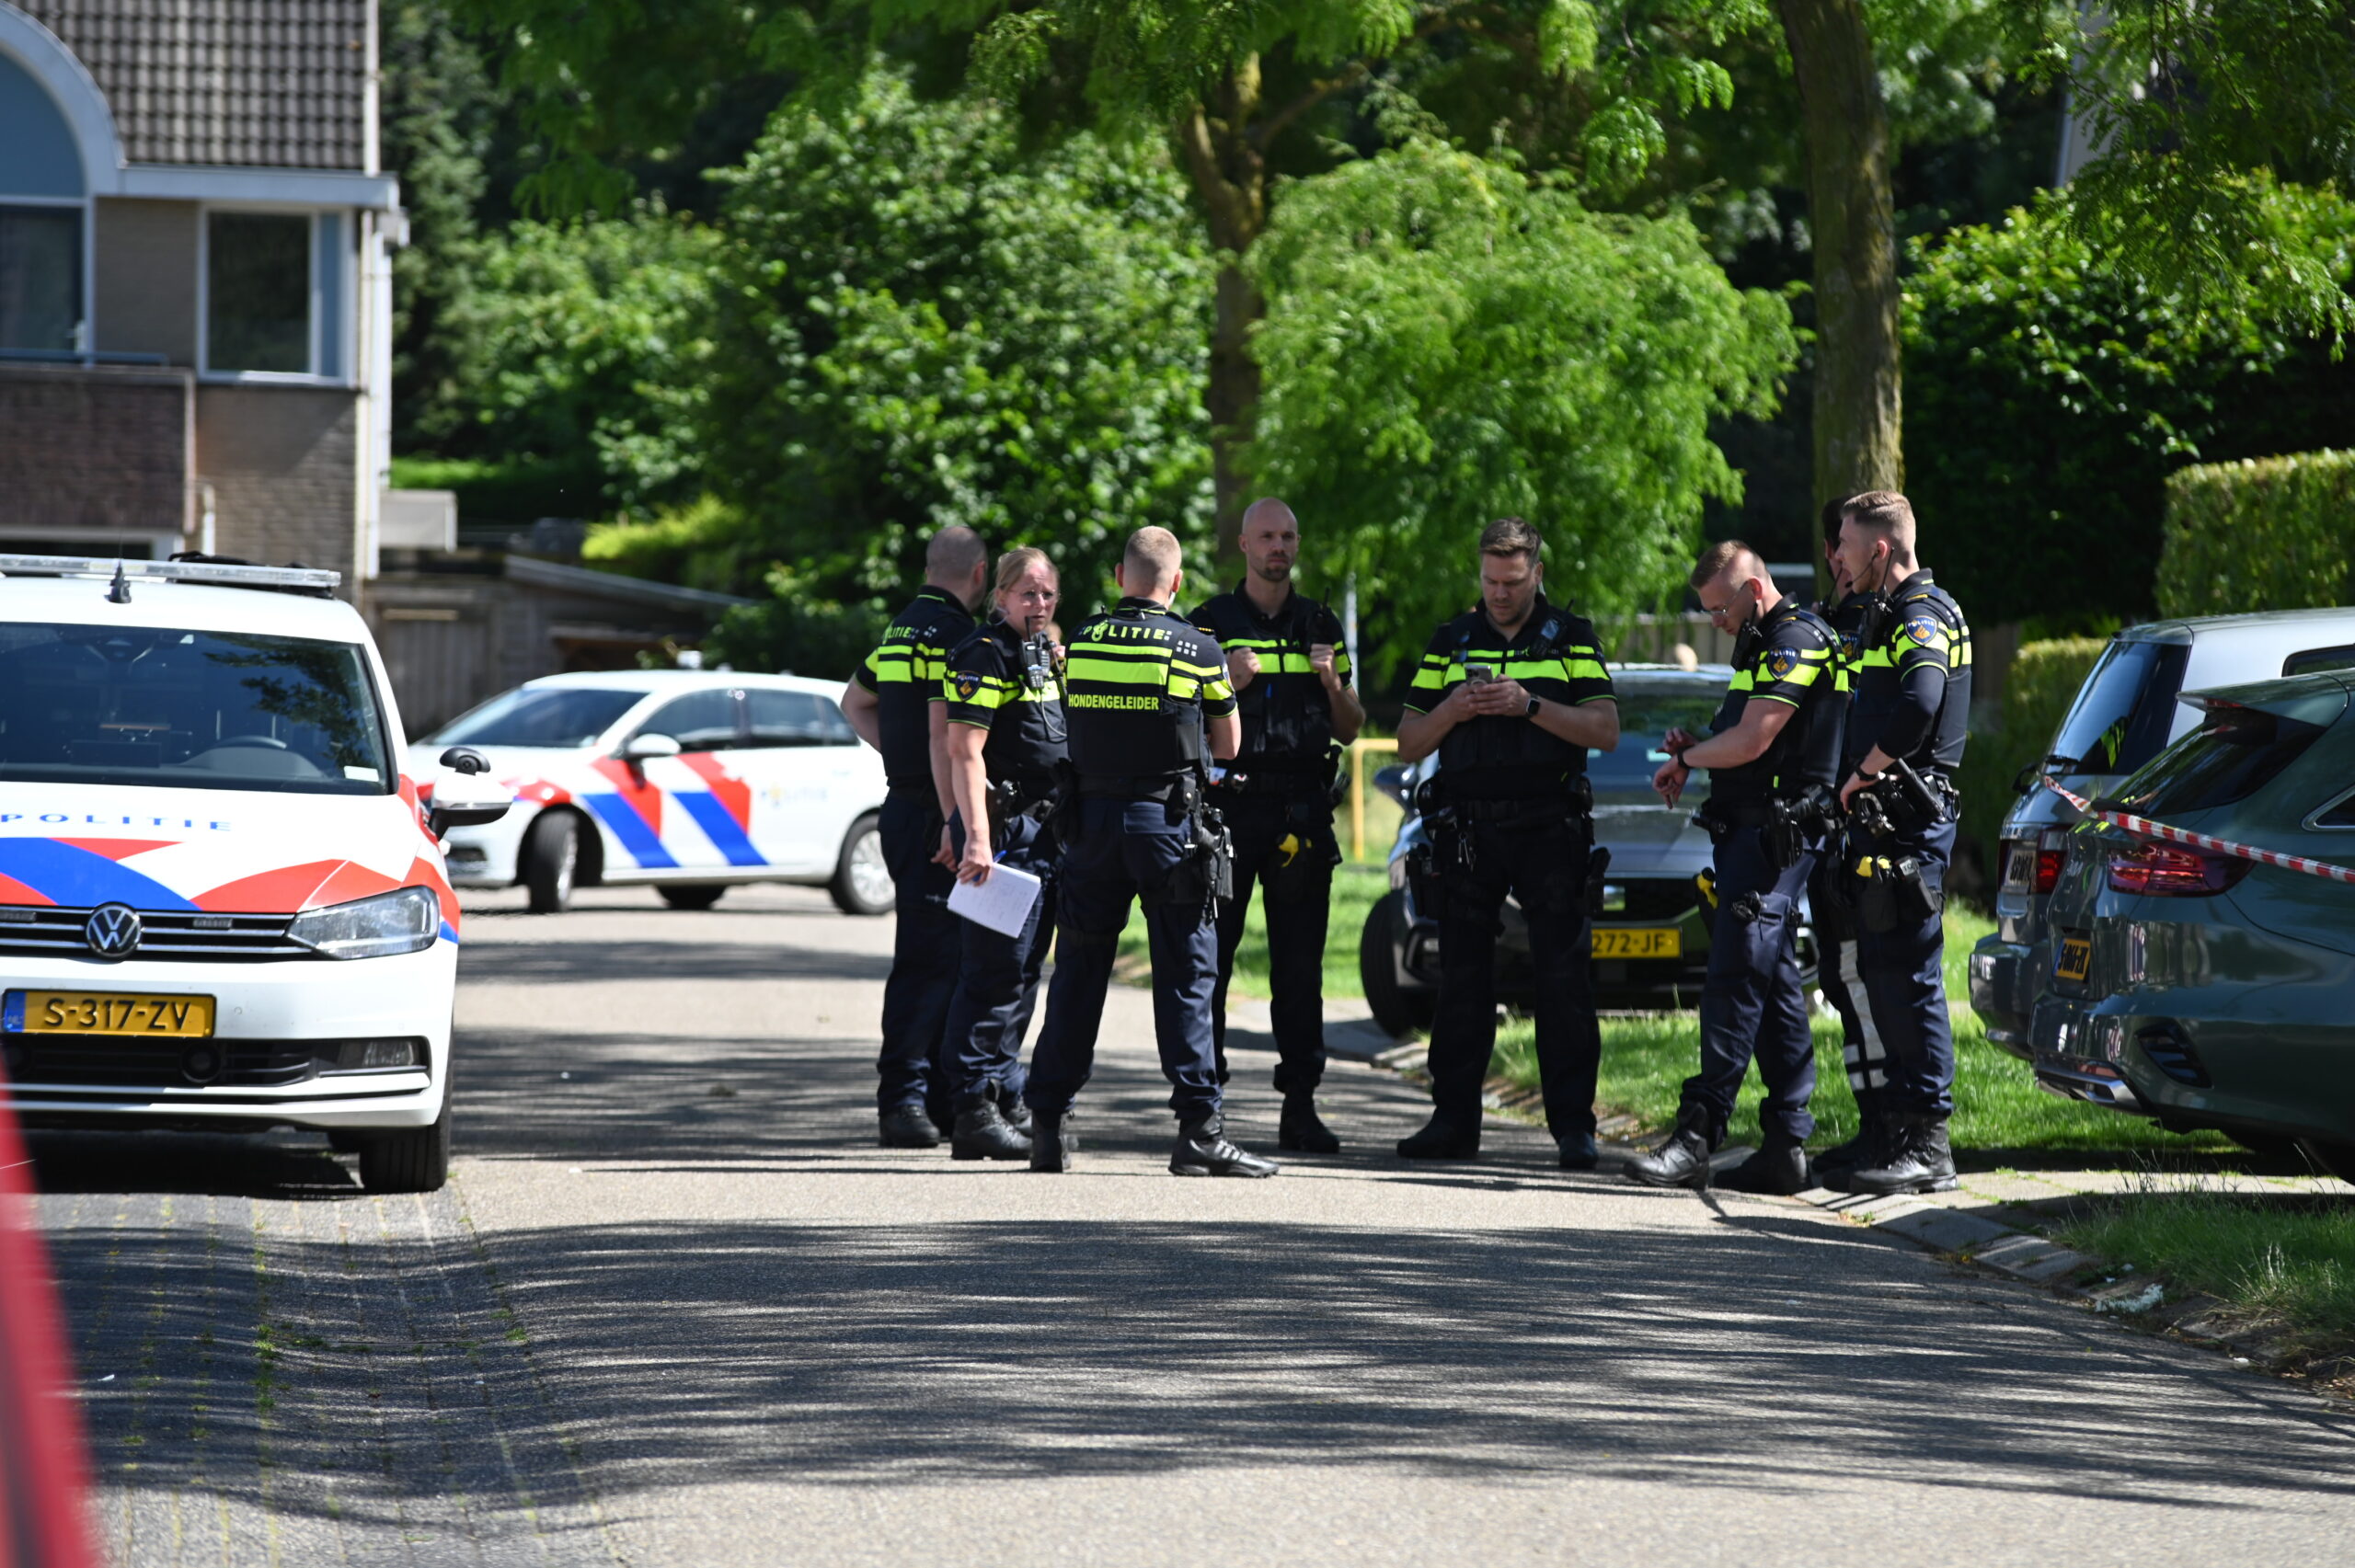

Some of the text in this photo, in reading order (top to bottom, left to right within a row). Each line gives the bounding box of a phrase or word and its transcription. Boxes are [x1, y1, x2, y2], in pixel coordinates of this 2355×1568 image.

[1082, 619, 1166, 642] POLITIE
[1067, 693, 1160, 711] HONDENGELEIDER
[0, 813, 231, 831] POLITIE
[44, 997, 191, 1031] S-317-ZV
